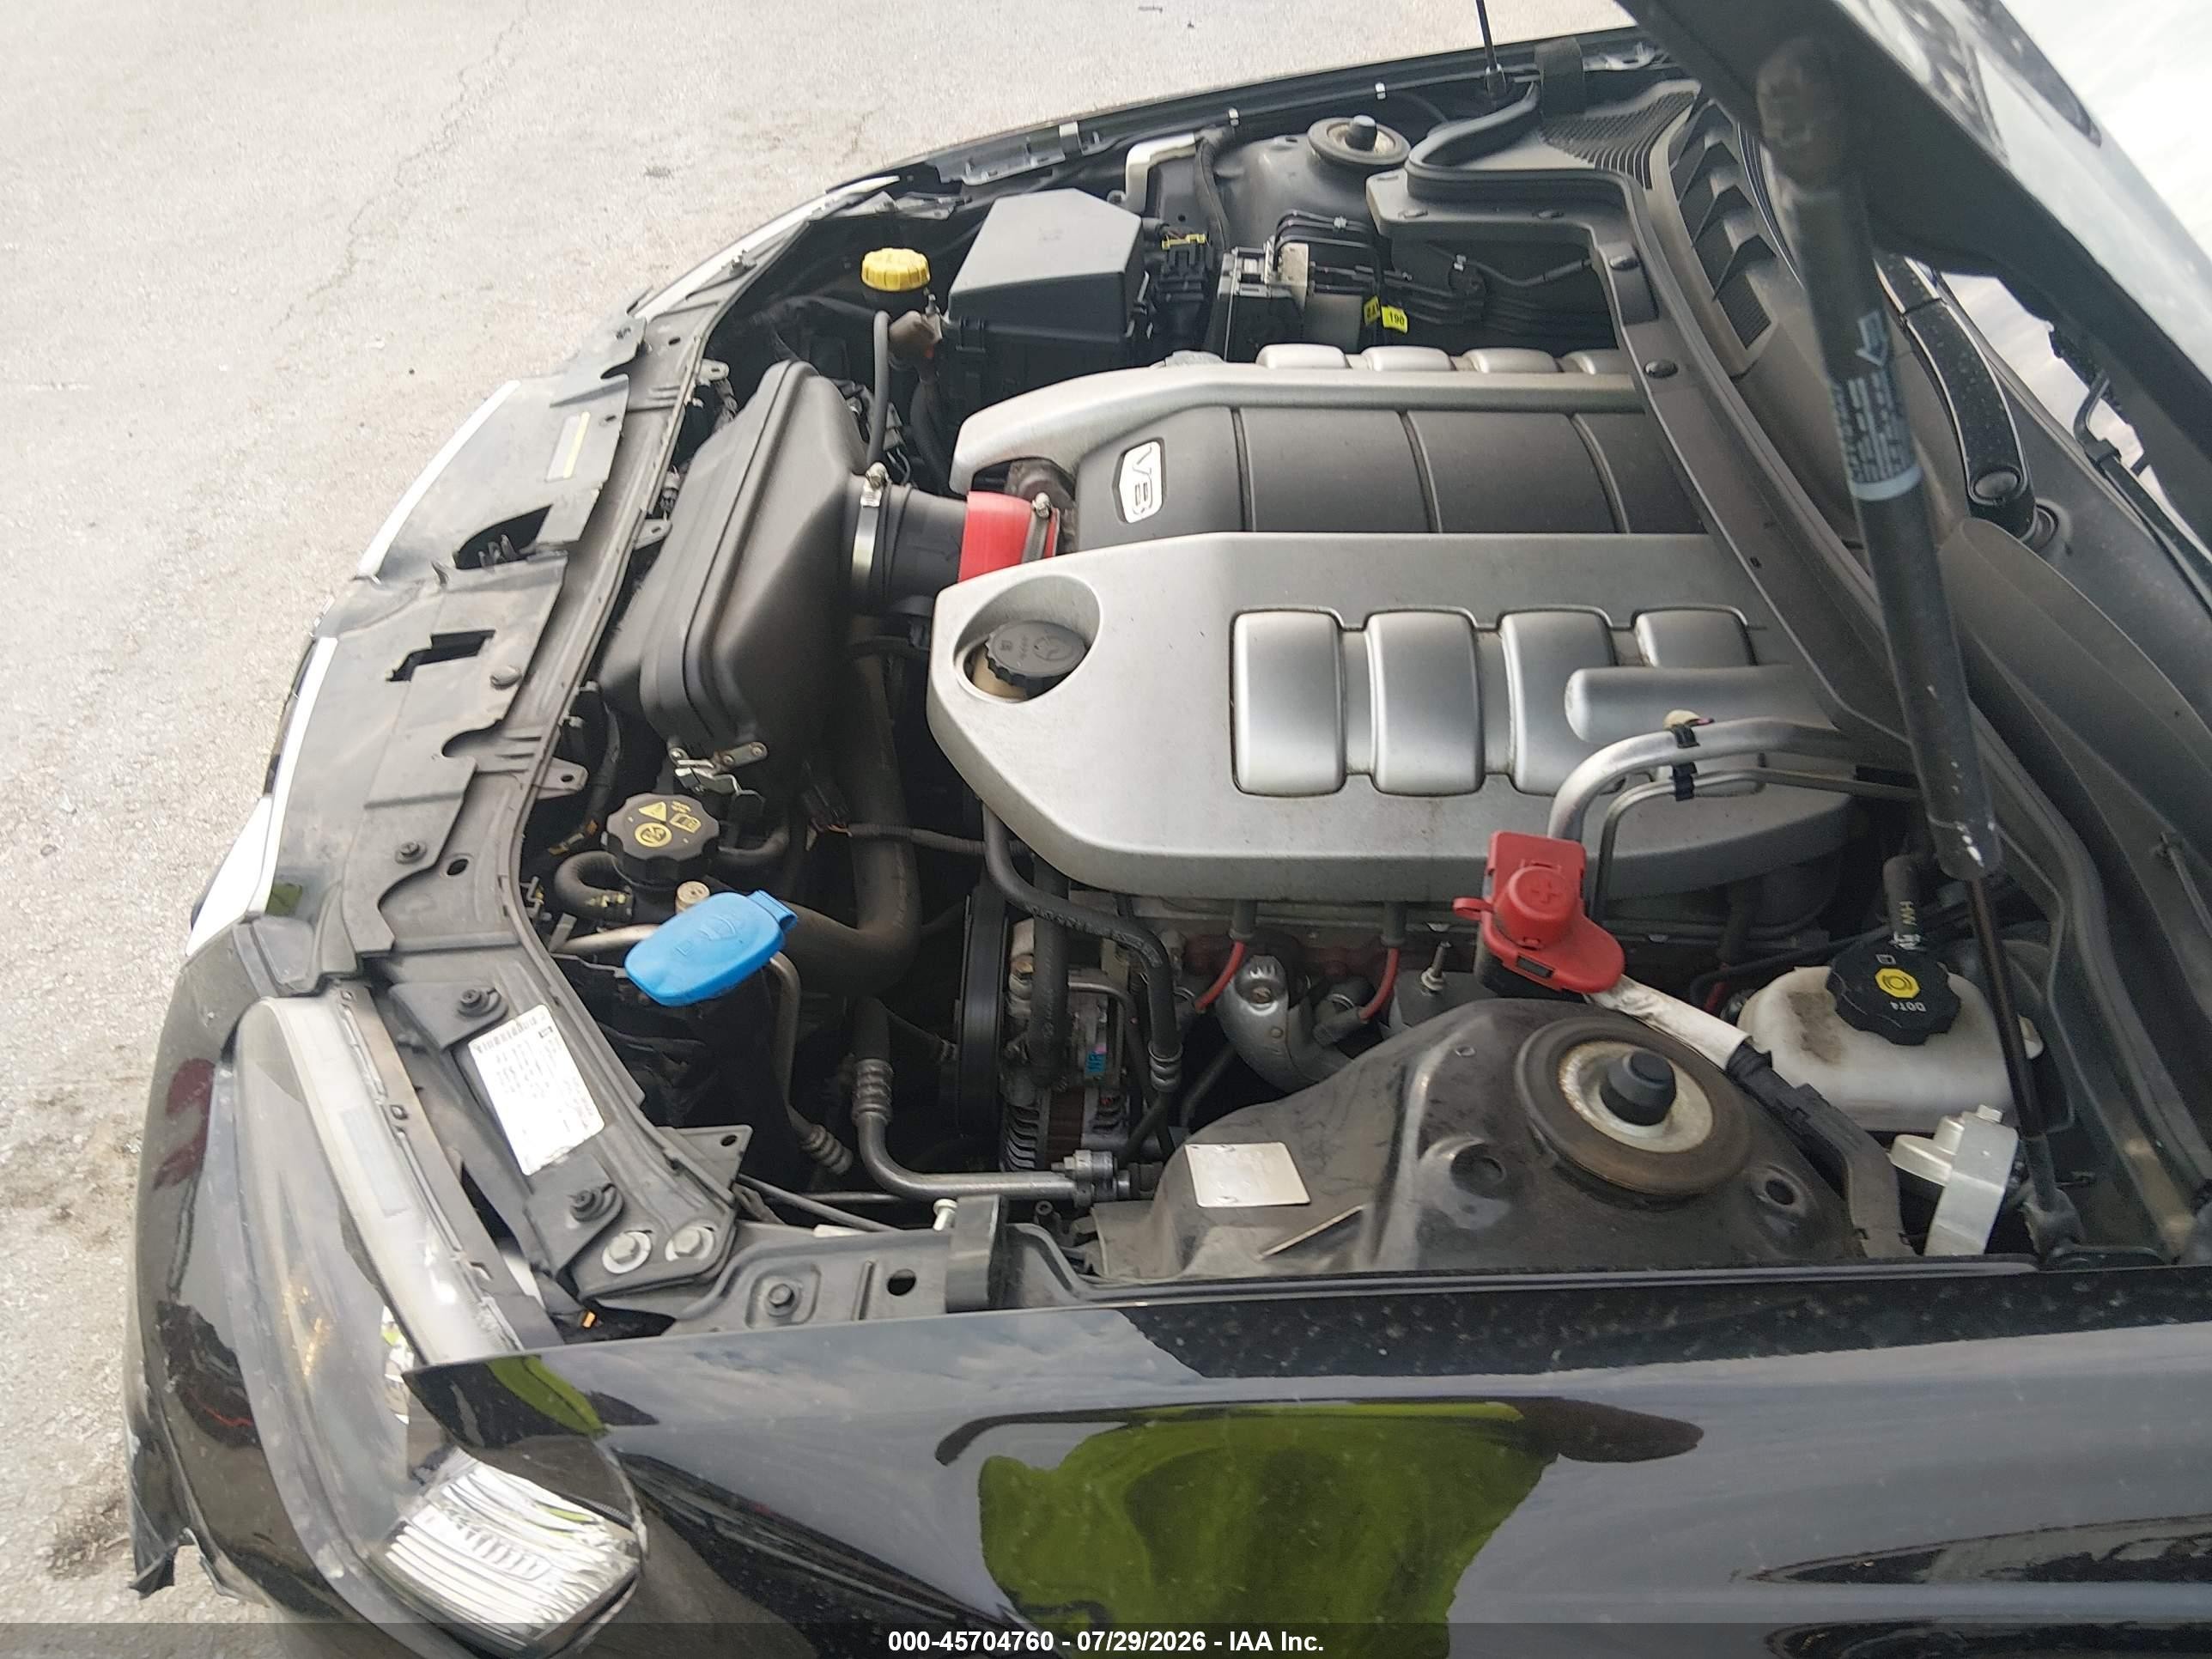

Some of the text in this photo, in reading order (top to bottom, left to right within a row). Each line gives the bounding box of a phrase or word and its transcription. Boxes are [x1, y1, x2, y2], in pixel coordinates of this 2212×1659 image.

[1389, 311, 1404, 325] 190
[1131, 445, 1153, 515] V8
[1891, 1001, 1927, 1012] DOT4
